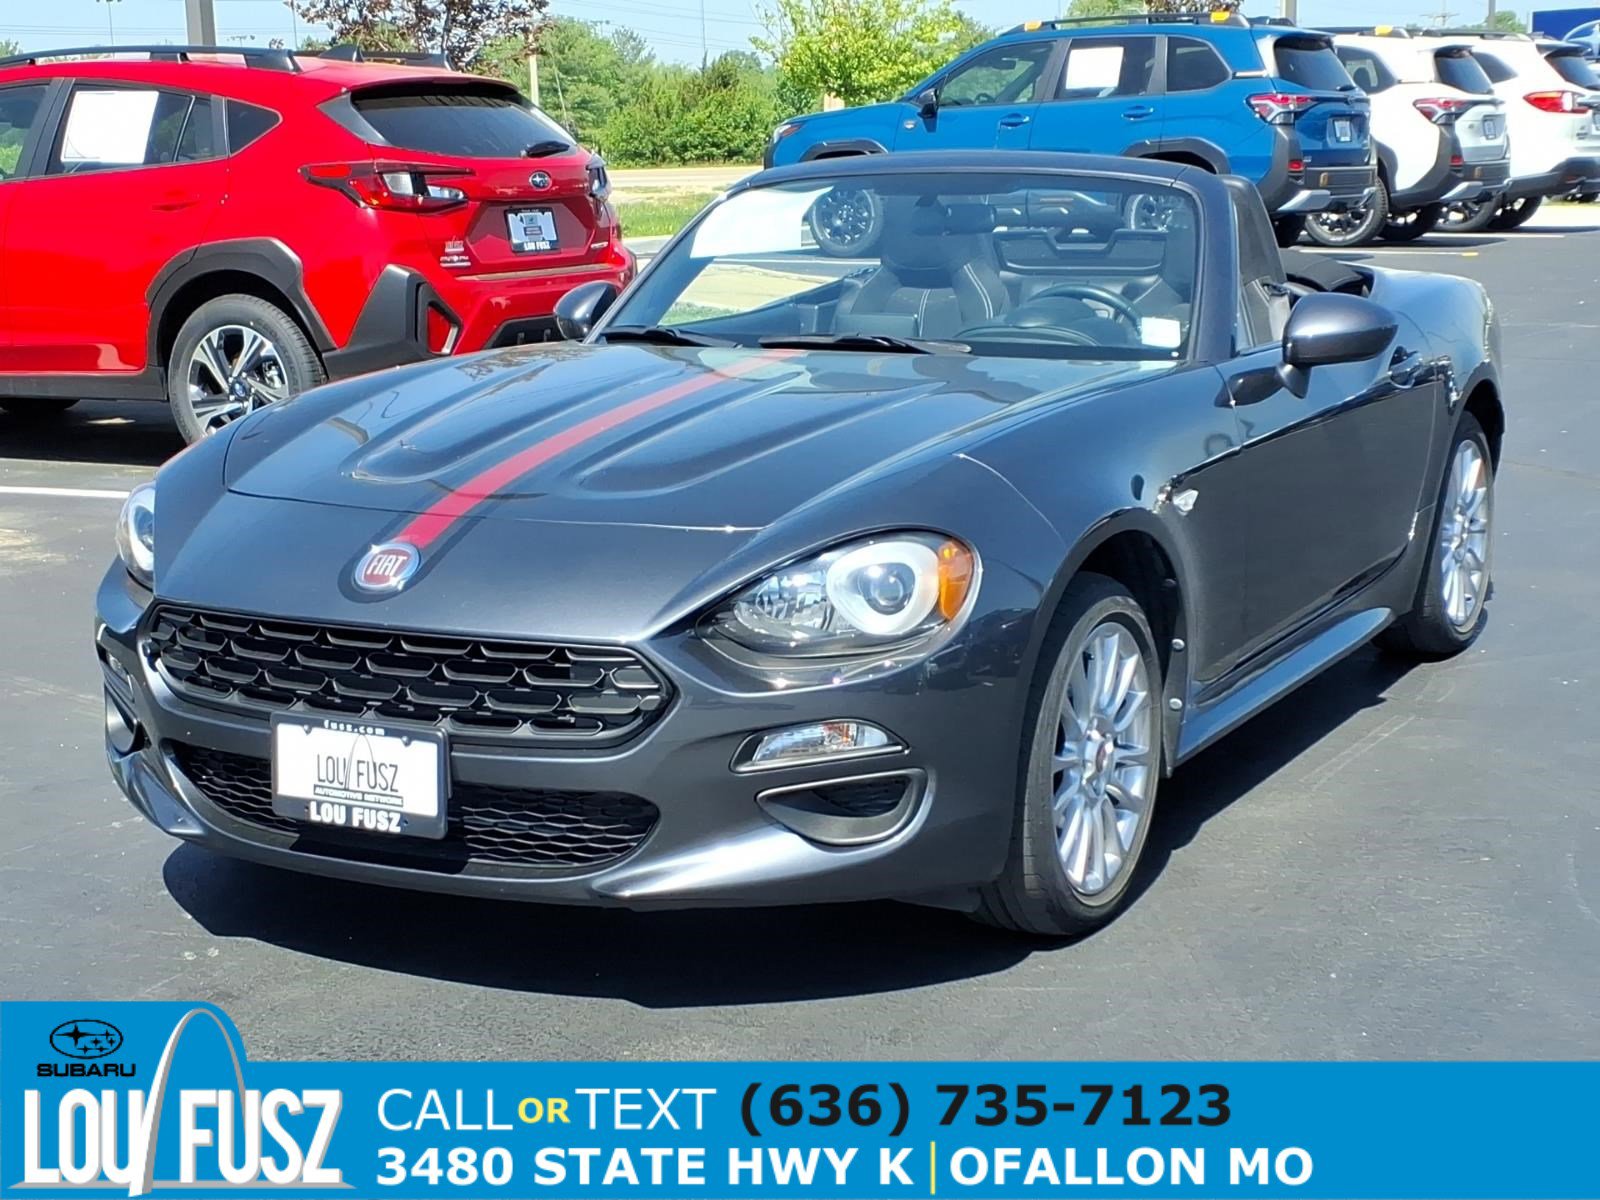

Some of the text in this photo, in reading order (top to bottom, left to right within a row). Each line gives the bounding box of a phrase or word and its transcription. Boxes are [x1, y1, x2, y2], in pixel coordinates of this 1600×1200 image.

[366, 554, 408, 577] FIAT
[316, 753, 399, 793] LOU FUSZ
[310, 800, 401, 833] LOU FUSZ
